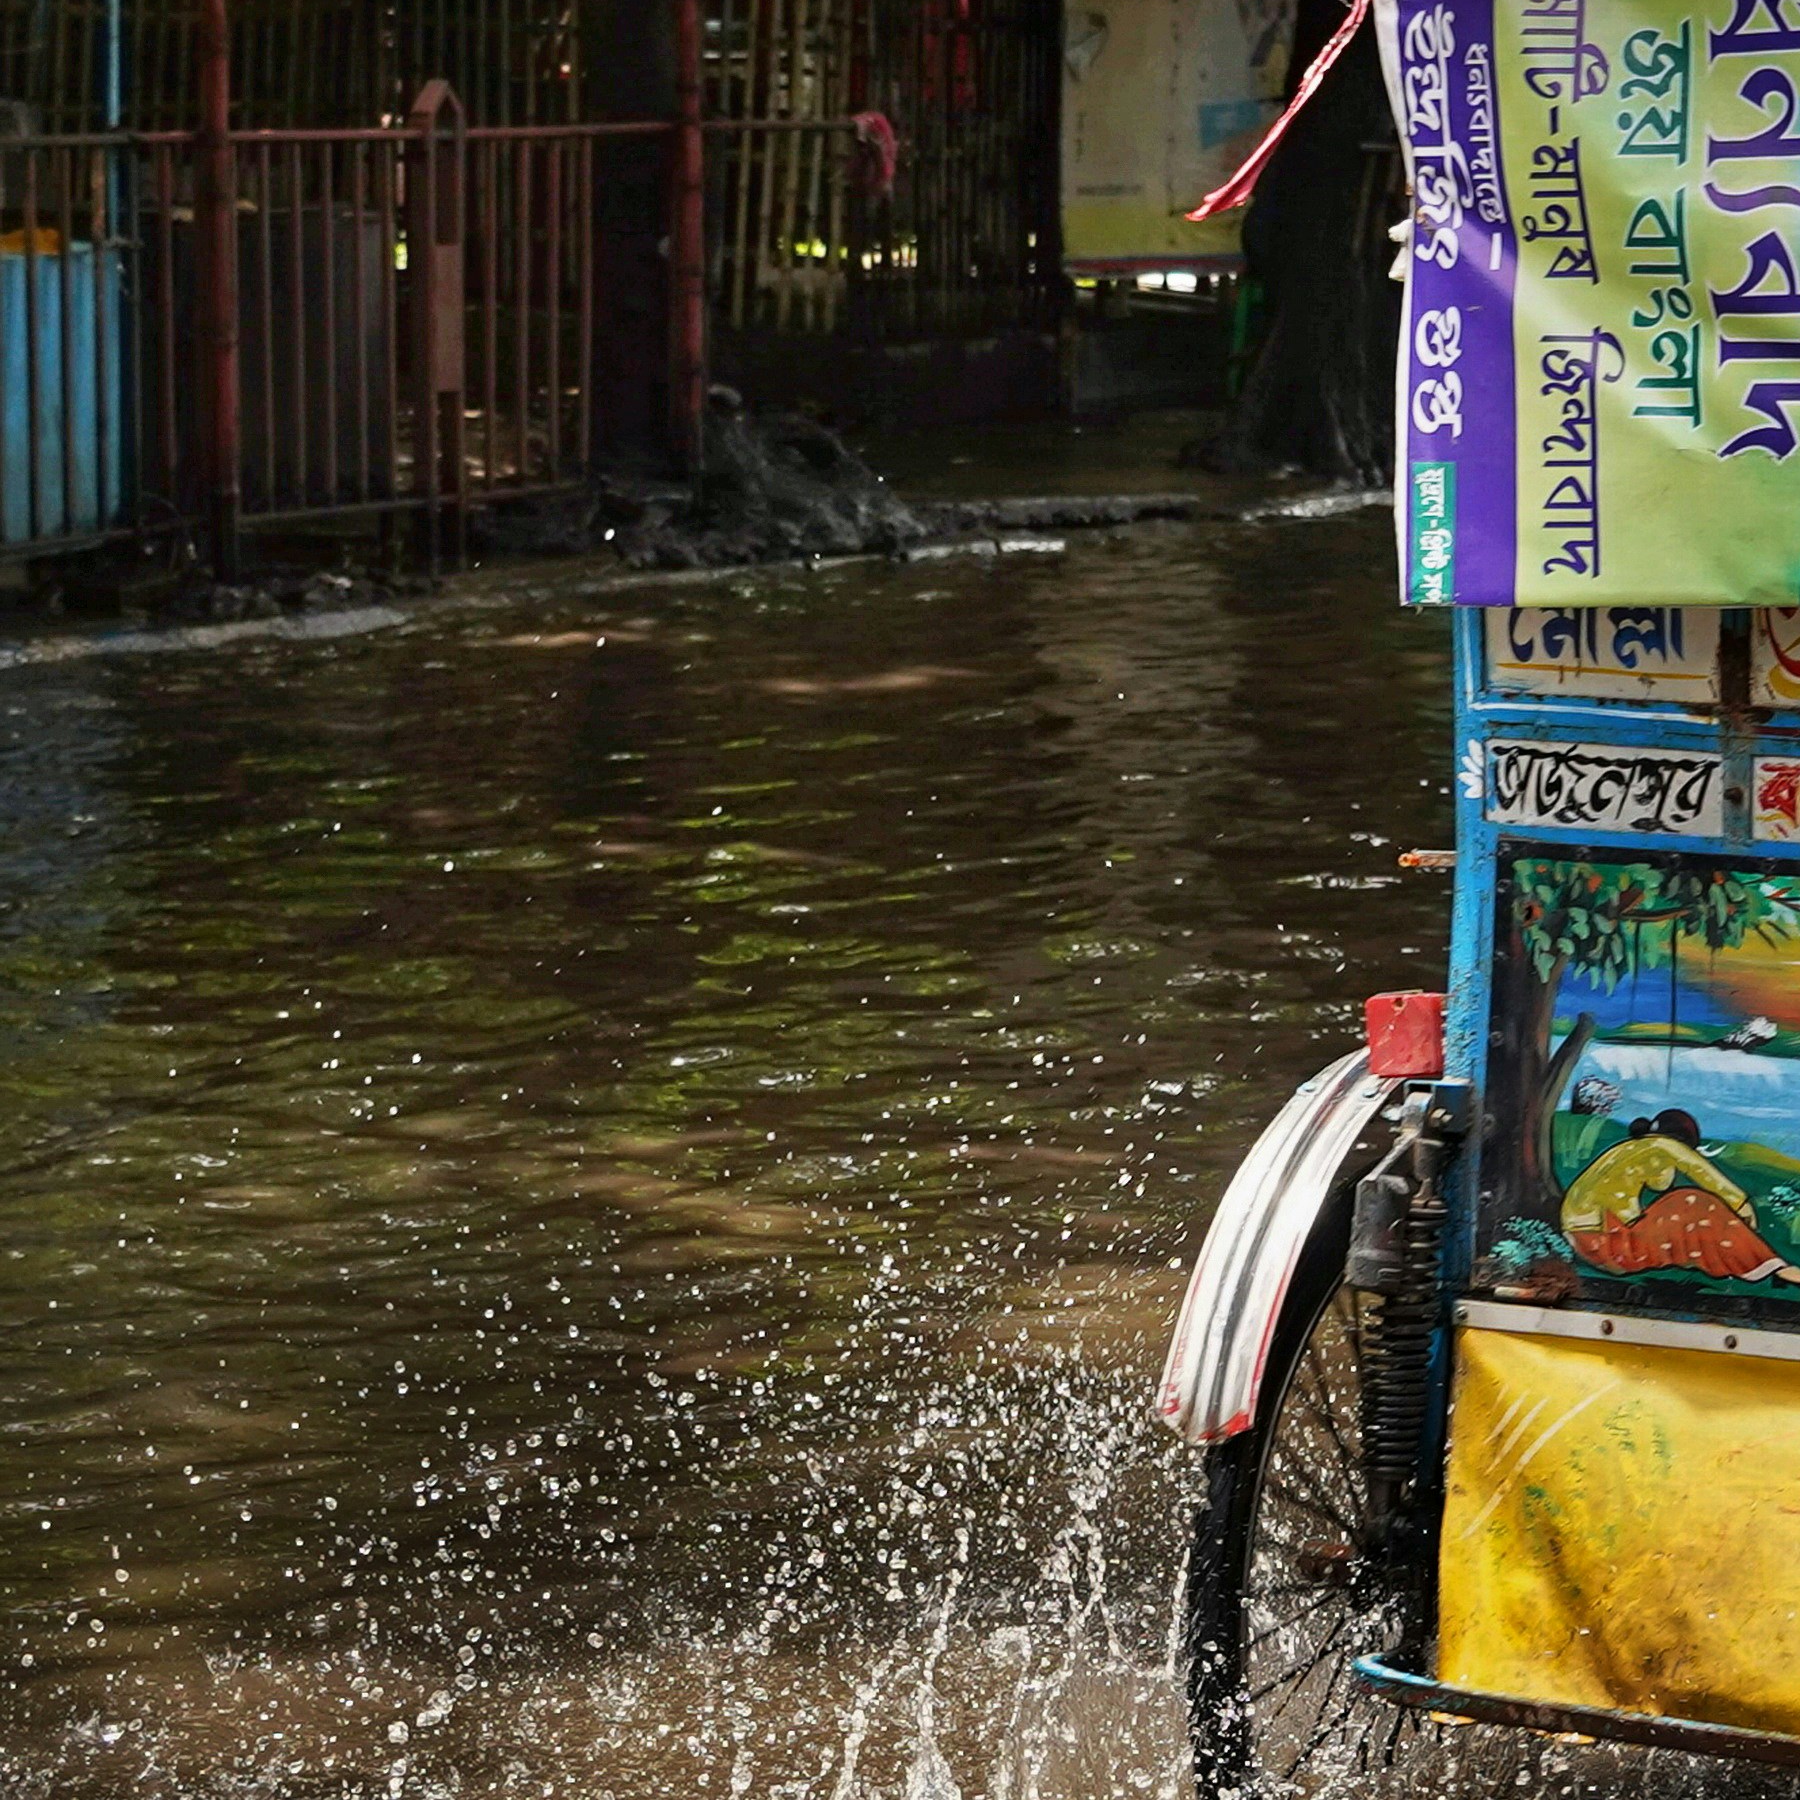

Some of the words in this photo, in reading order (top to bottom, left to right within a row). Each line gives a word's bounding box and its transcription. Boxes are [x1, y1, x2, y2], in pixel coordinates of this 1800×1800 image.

[1619, 18, 1693, 166] জয়
[1625, 185, 1703, 429] বাংলা
[1540, 326, 1626, 579] জিন্দাবাদ
